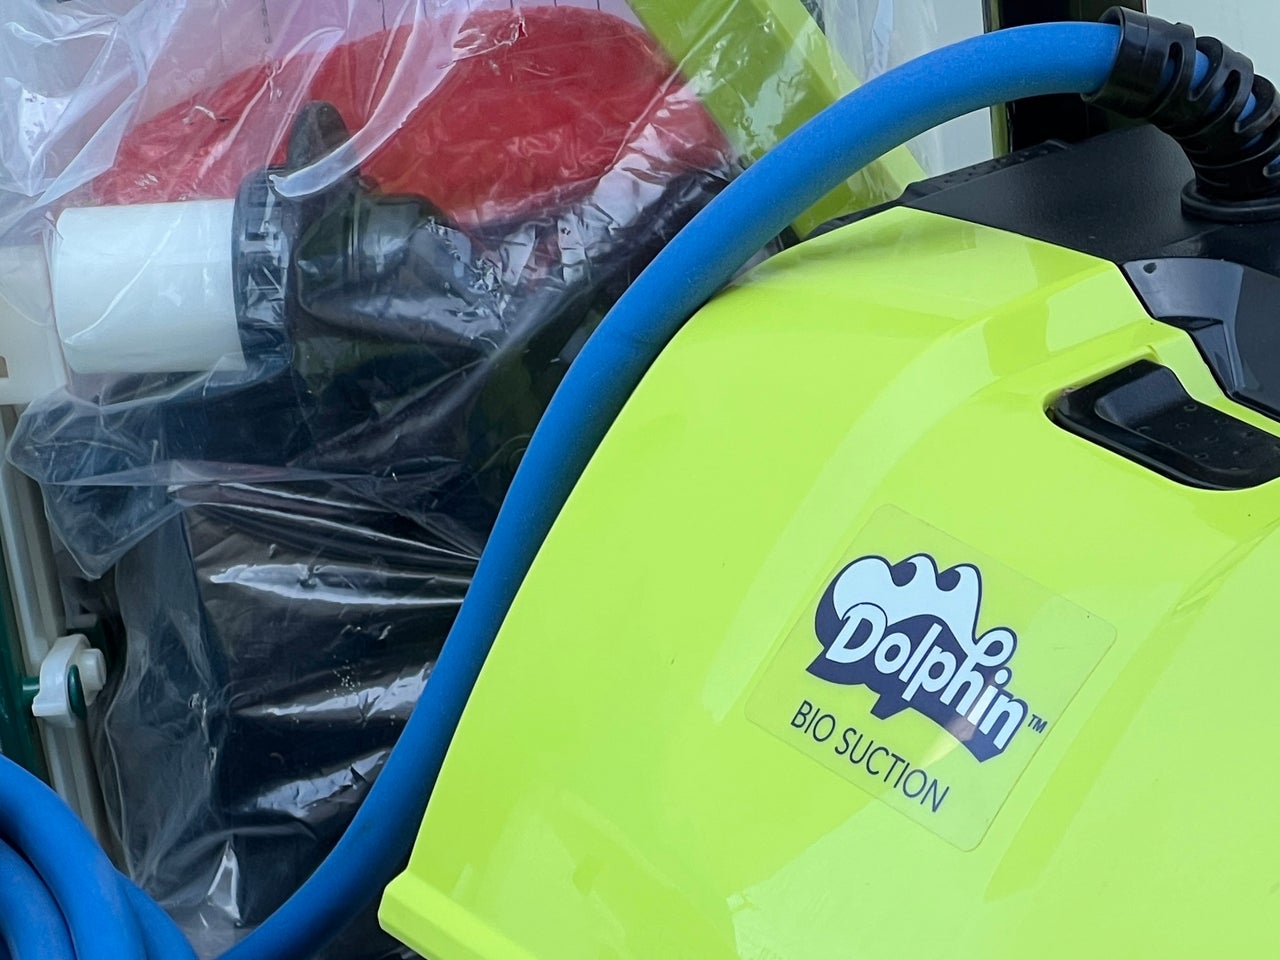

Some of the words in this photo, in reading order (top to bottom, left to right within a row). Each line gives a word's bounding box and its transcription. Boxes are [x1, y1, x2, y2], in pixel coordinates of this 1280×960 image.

[824, 602, 1024, 751] Dolphin
[790, 699, 837, 743] BIO
[833, 726, 950, 813] SUCTION
